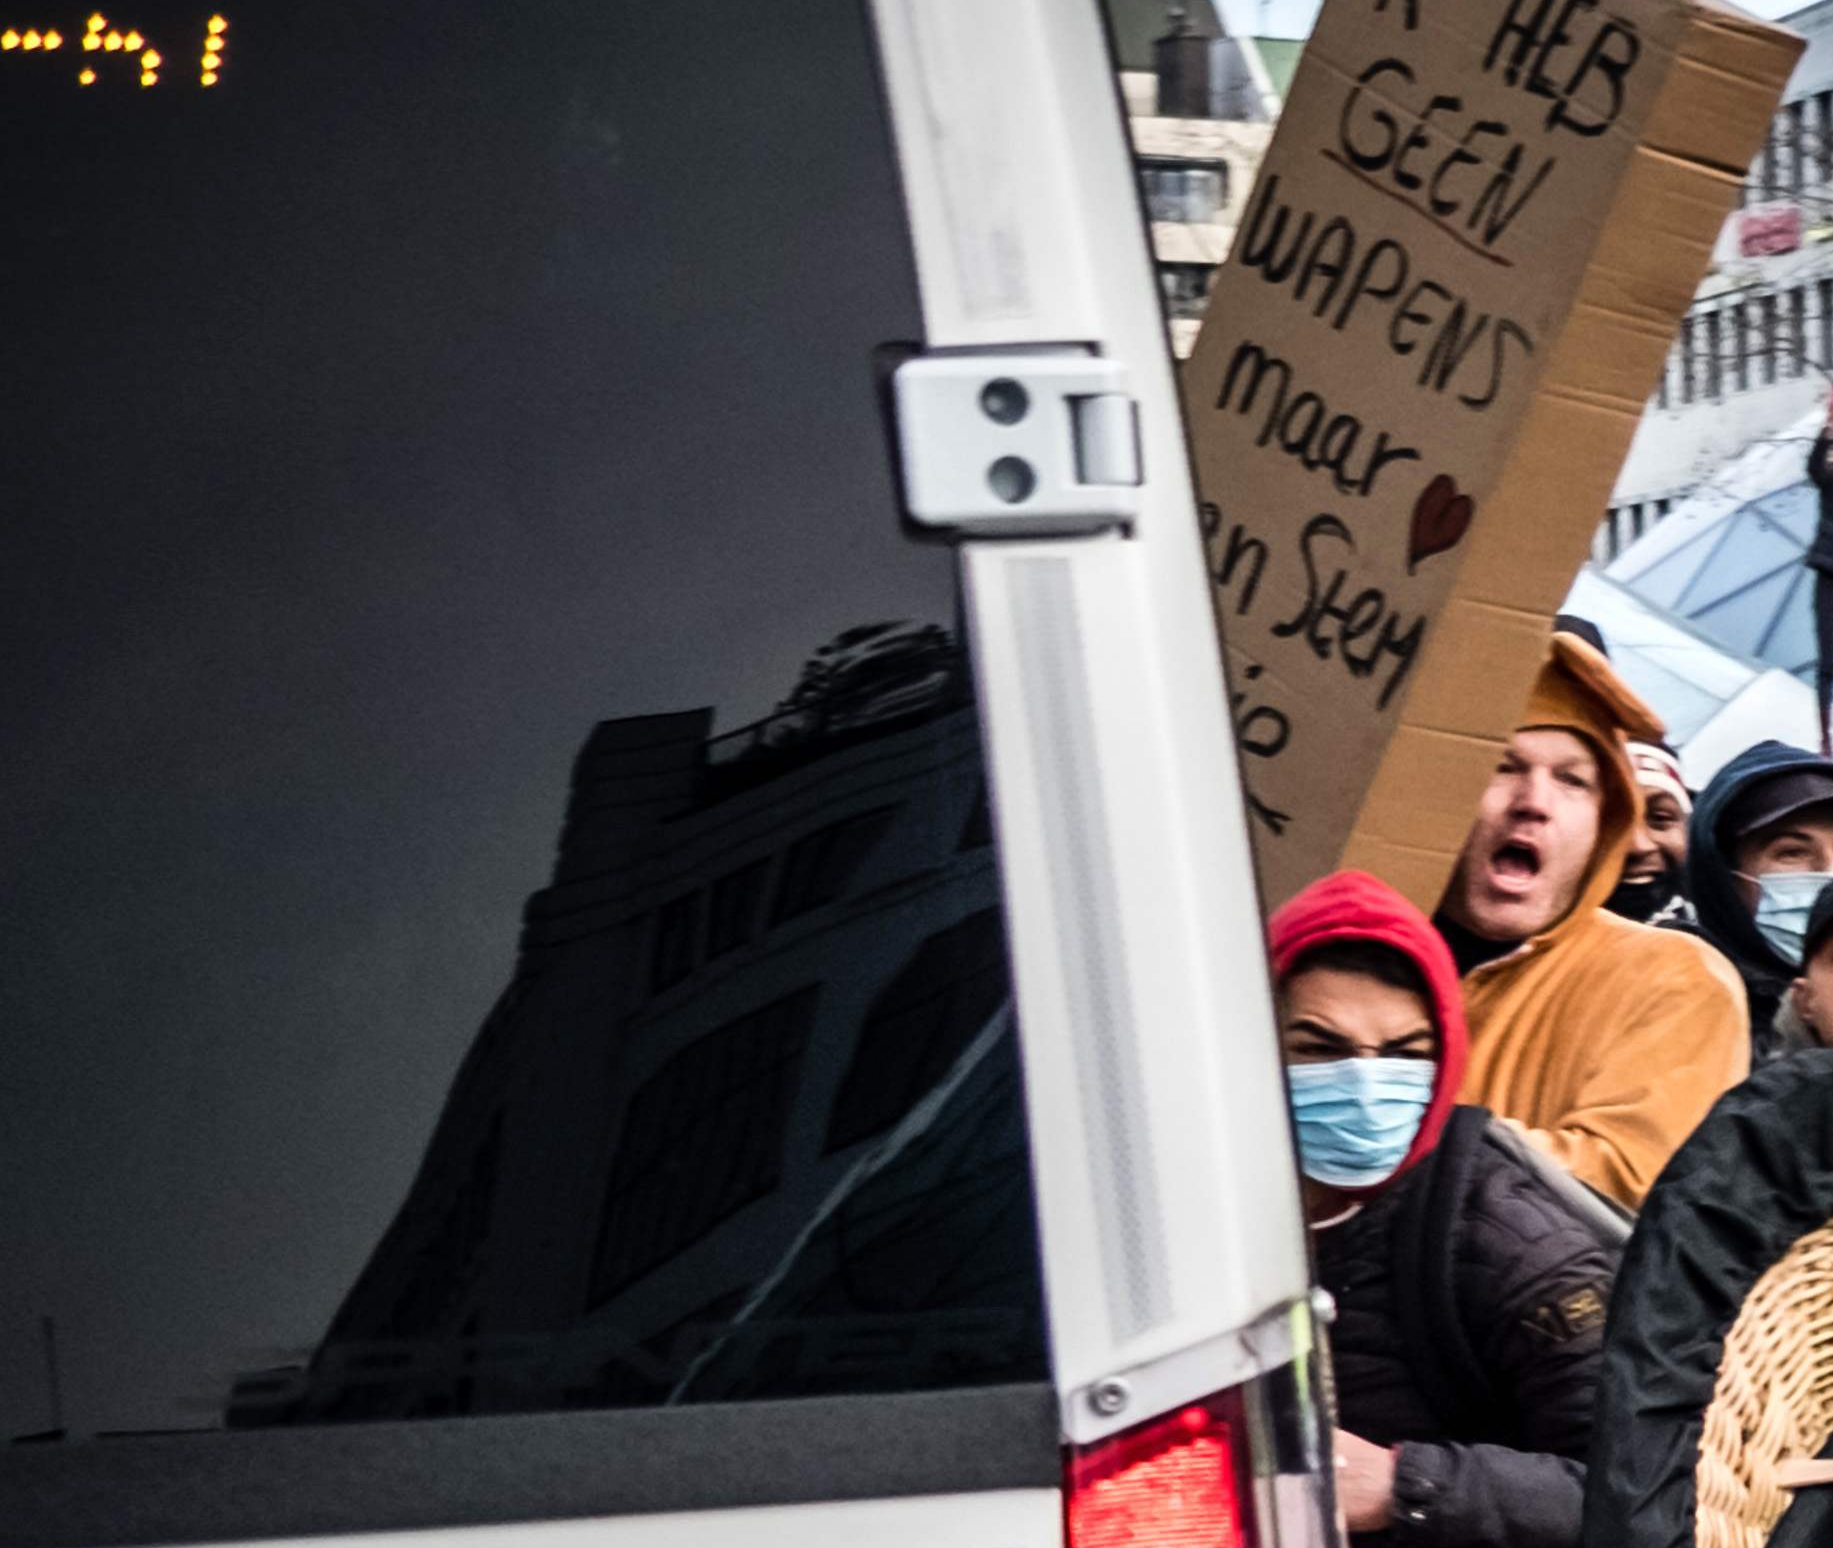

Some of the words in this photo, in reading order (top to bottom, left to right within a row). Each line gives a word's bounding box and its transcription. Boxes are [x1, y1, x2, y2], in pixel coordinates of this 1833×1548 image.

[1339, 58, 1557, 246] GEEN
[1480, 0, 1642, 137] HEB
[1238, 174, 1535, 411] WAPENS
[1216, 340, 1422, 497] maar
